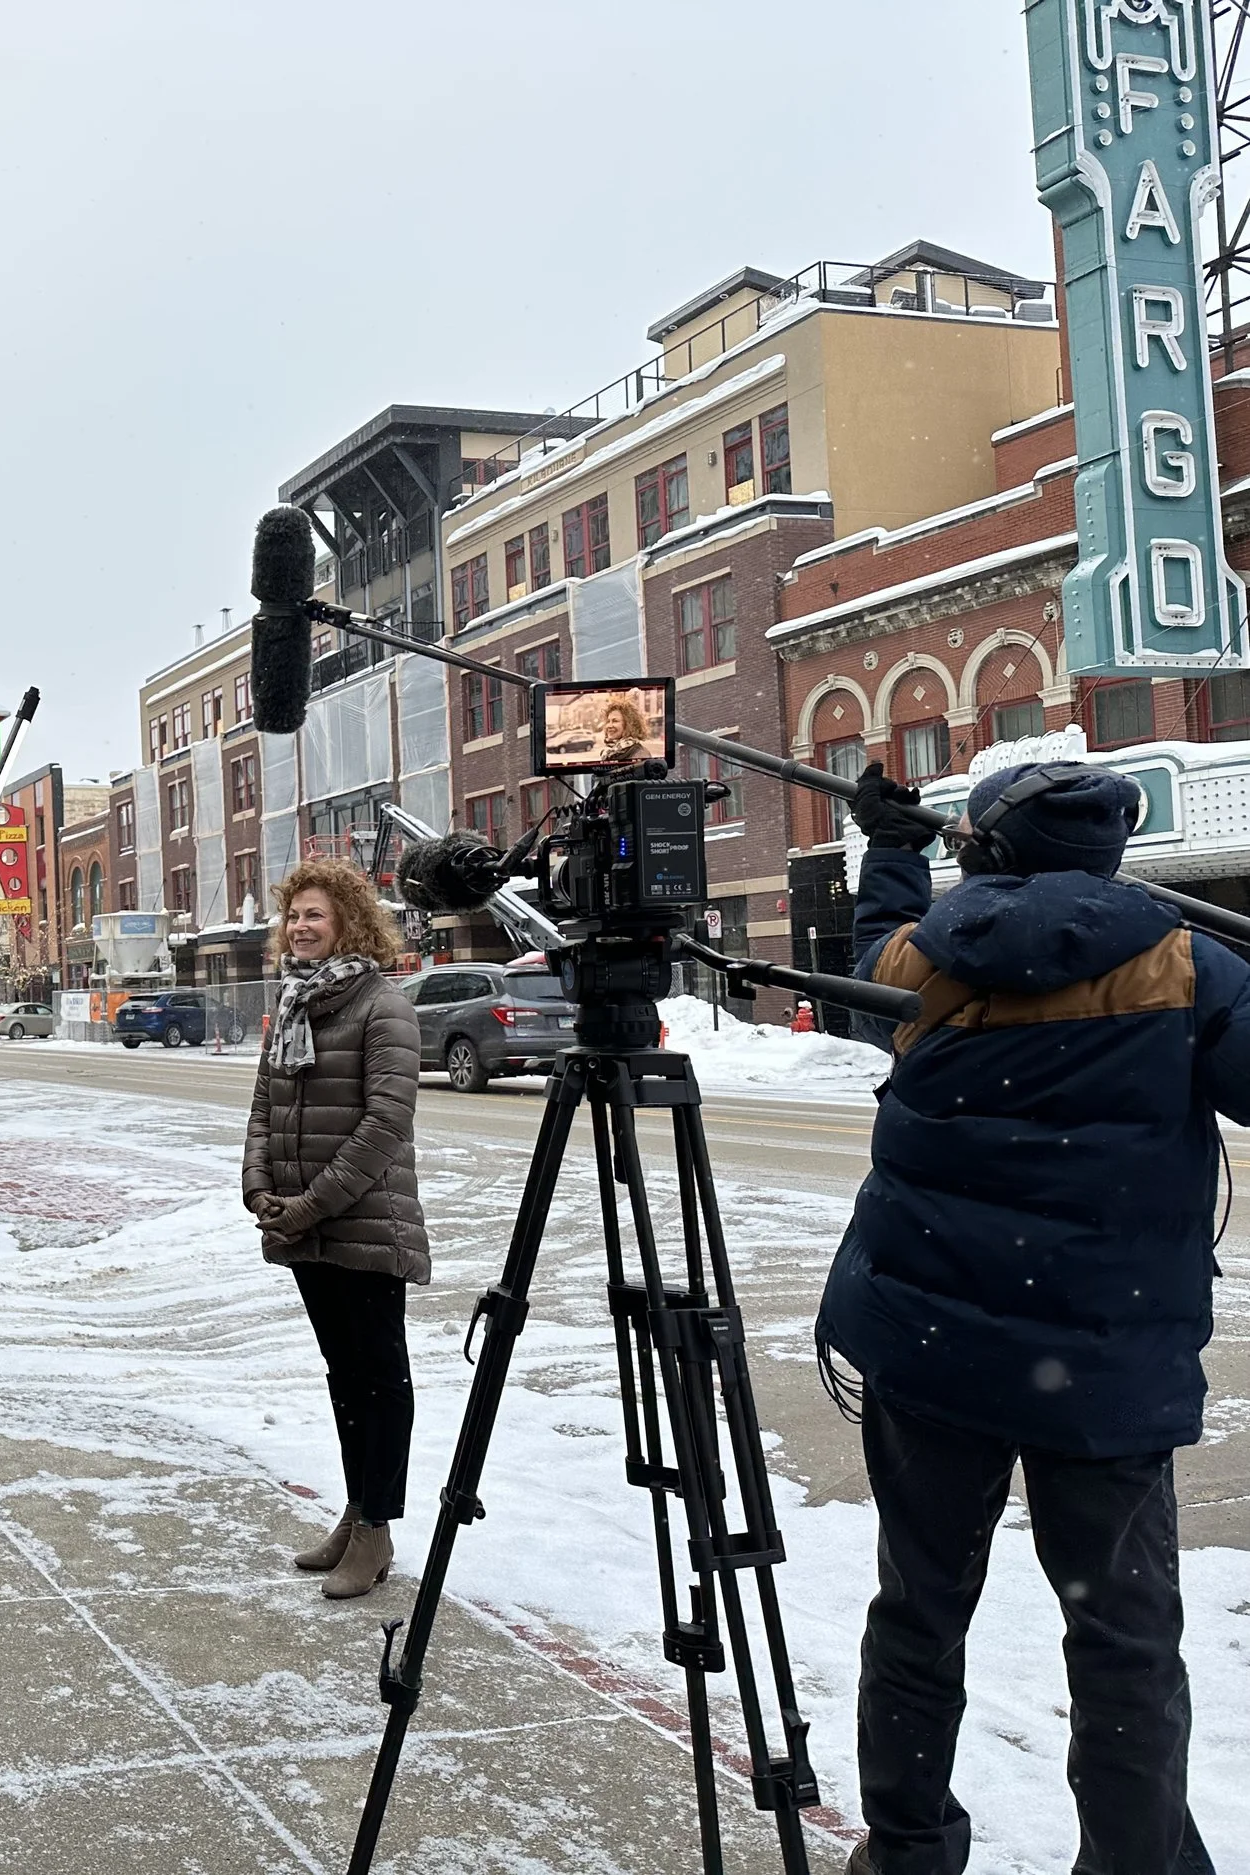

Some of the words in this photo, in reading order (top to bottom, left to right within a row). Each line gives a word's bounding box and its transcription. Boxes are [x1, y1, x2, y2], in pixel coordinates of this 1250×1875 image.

[1116, 52, 1206, 627] FARGO
[645, 793, 661, 801] GEN
[662, 792, 692, 800] ENERGY
[0, 829, 24, 840] Pizza
[650, 841, 670, 849] SHOCK
[650, 847, 670, 855] SHORT
